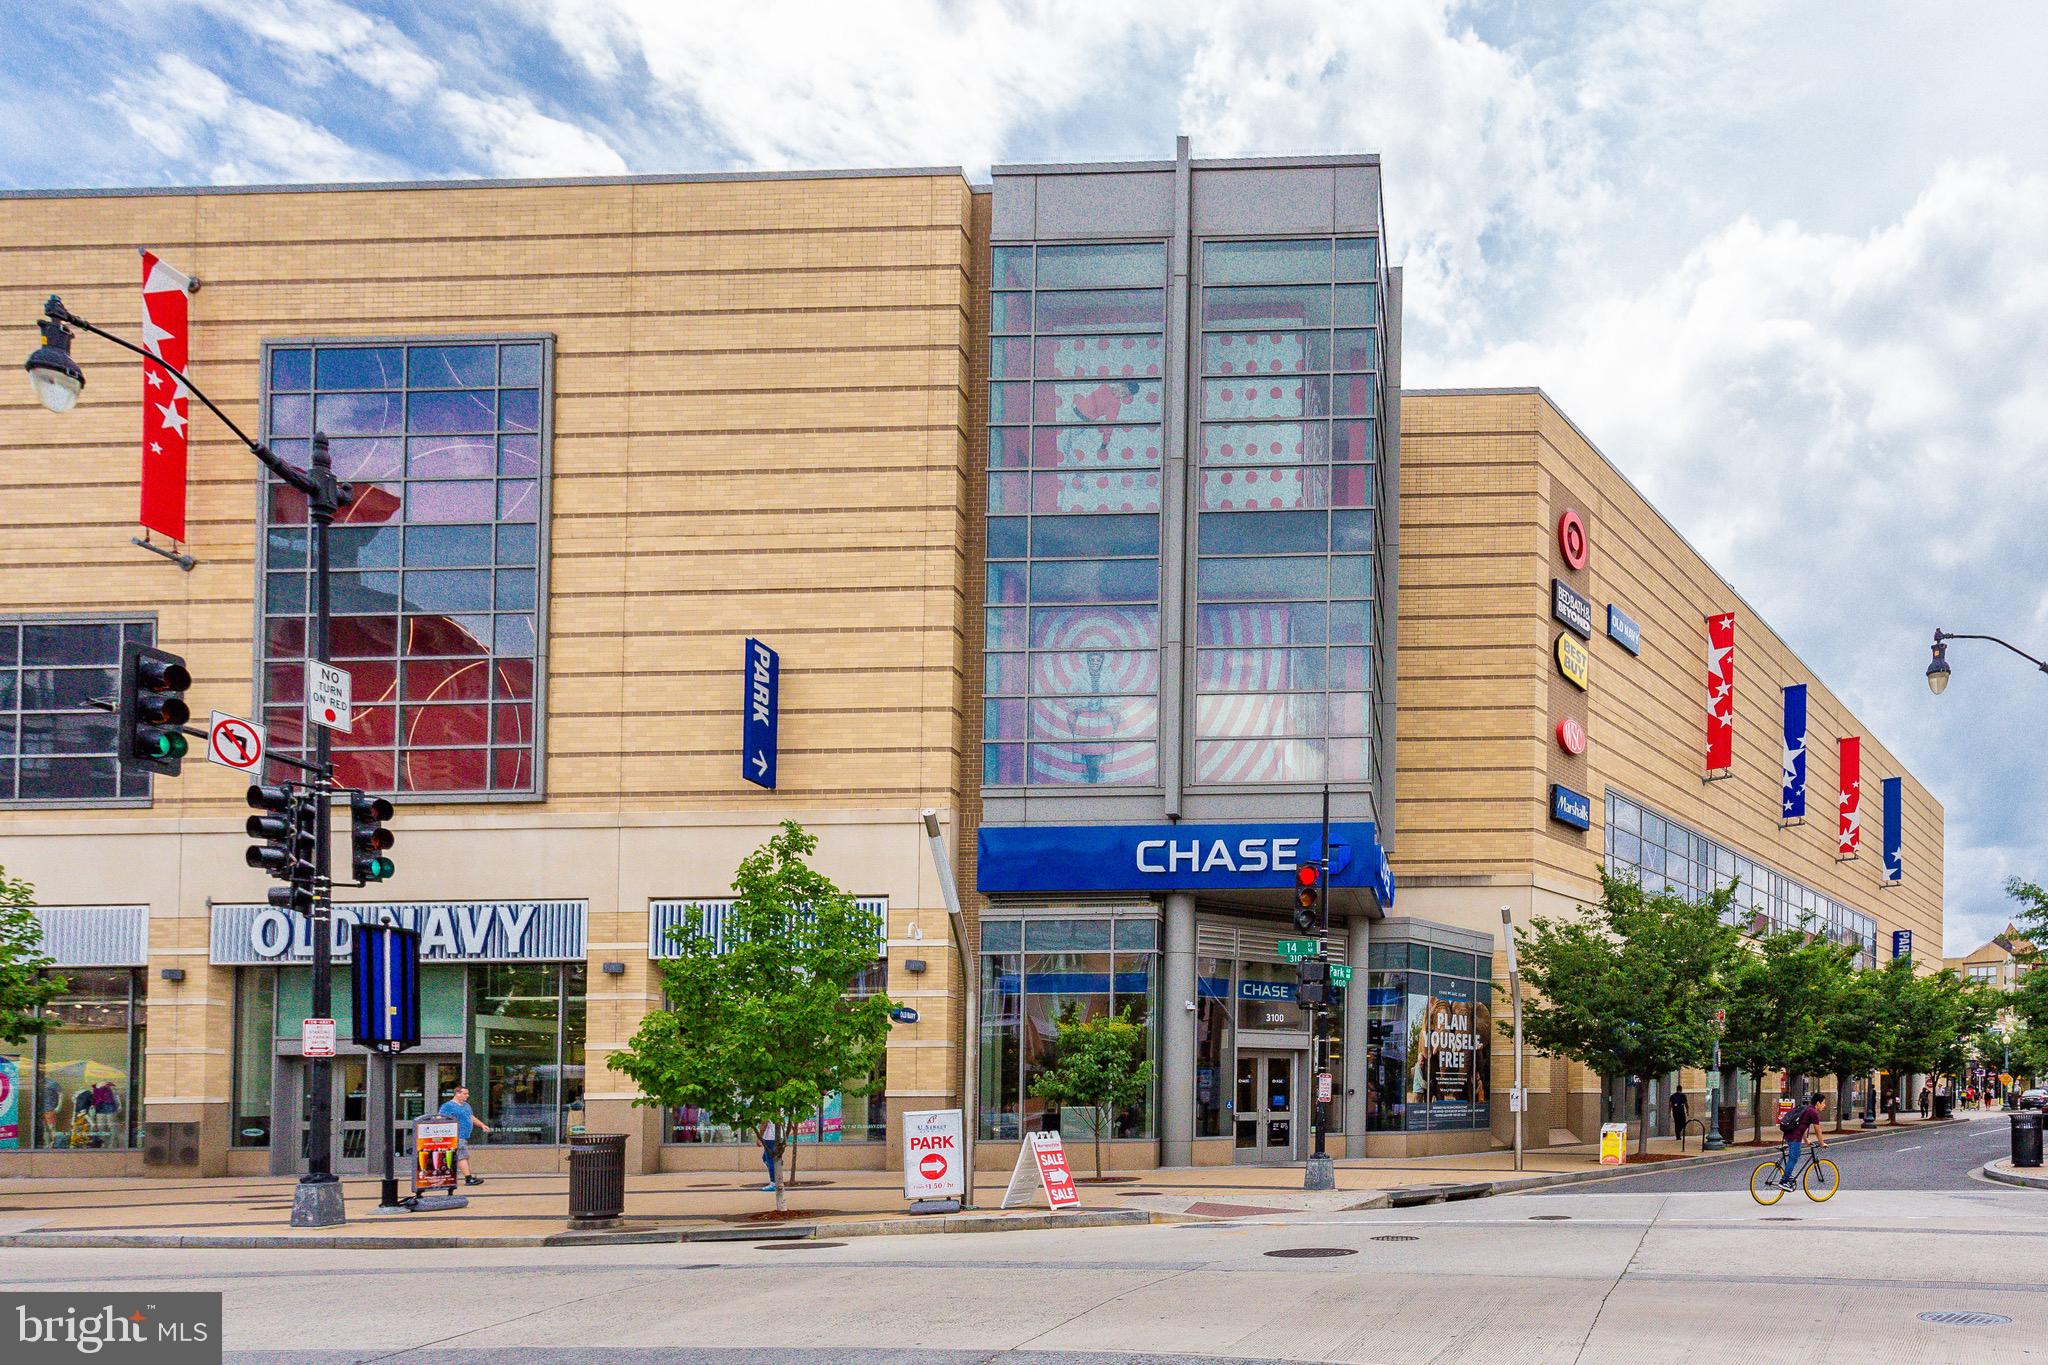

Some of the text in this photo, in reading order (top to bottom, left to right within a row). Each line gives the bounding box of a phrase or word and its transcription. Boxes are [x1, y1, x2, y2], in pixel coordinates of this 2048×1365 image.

[1558, 586, 1571, 606] BED
[1570, 596, 1585, 617] BATH
[1558, 601, 1591, 632] BEYOND
[1611, 615, 1640, 645] OLD NAVY
[1563, 638, 1587, 668] BEST
[321, 668, 340, 684] NO
[1563, 654, 1585, 679] BUY
[318, 681, 343, 697] TURN
[752, 644, 771, 727] PARK
[313, 692, 348, 711] ON RED
[1557, 795, 1589, 822] Marshalls
[1136, 838, 1300, 873] CHASE
[251, 908, 358, 957] OLD
[1286, 942, 1297, 953] 14
[1330, 966, 1345, 978] Park
[1243, 983, 1289, 998] CHASE
[1333, 979, 1346, 987] 1400
[1265, 1013, 1285, 1022] 3100
[1437, 1012, 1468, 1031] PLAN
[1423, 1030, 1481, 1050] YOURSELF
[1438, 1051, 1465, 1068] FREE
[910, 1135, 955, 1151] PARK
[1040, 1153, 1065, 1166] SALE
[1051, 1187, 1076, 1201] SALE
